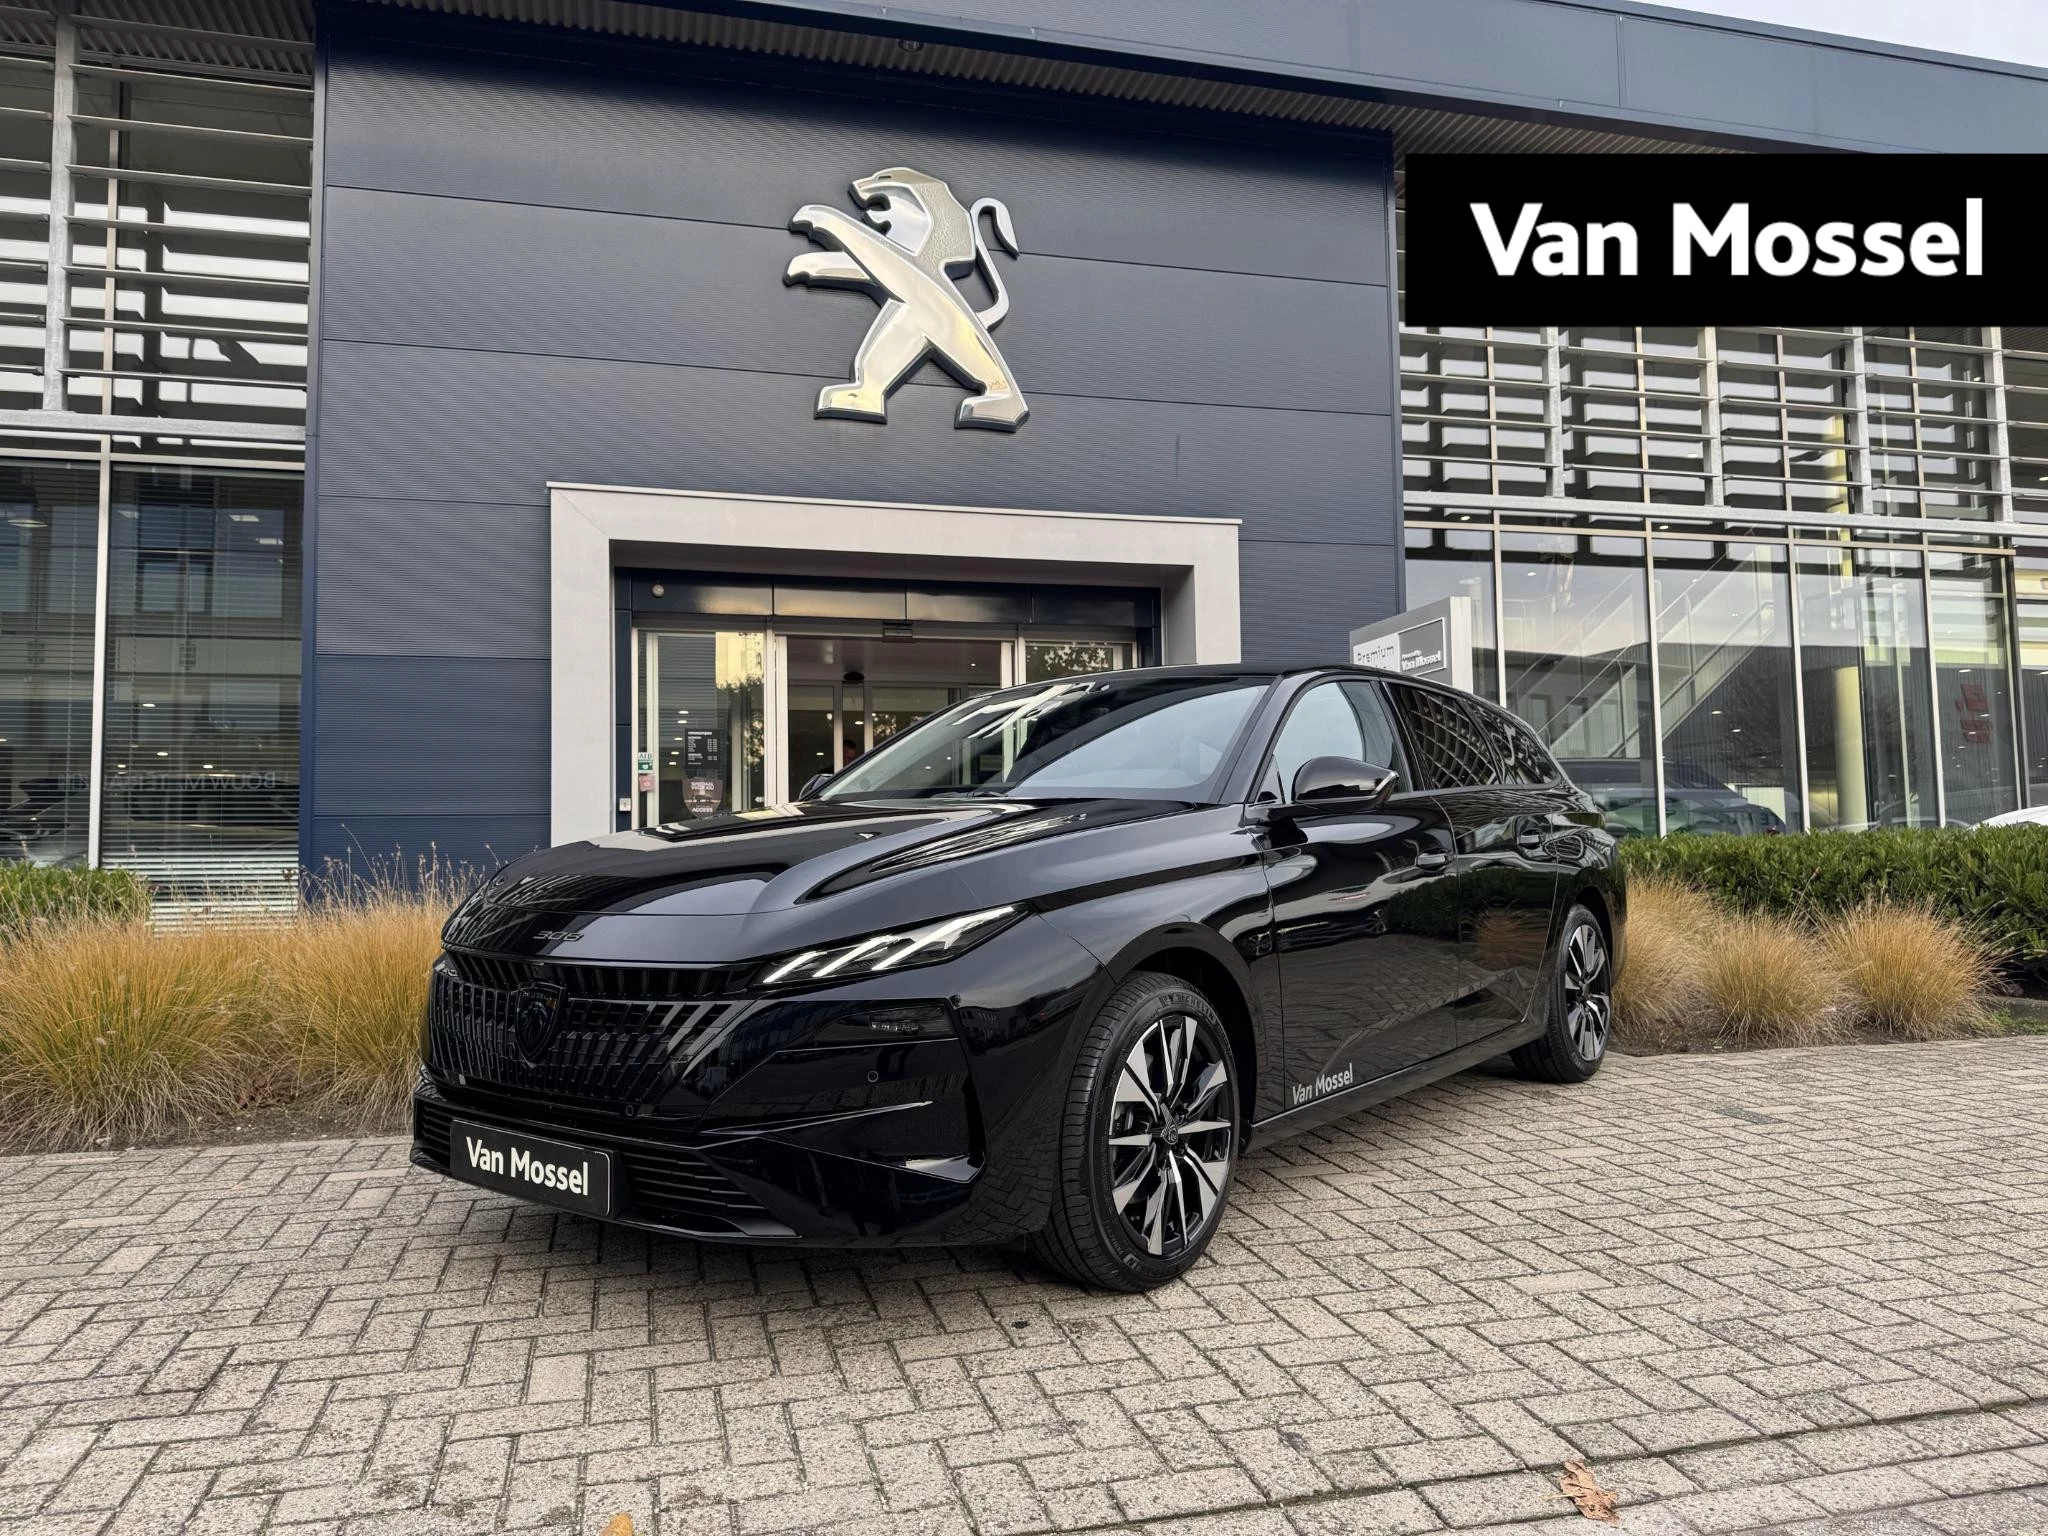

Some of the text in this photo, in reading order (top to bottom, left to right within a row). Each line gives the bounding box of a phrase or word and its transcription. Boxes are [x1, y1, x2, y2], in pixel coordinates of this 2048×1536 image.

[1357, 645, 1395, 663] Premium
[1401, 660, 1415, 671] Van
[1415, 650, 1441, 667] Mossel
[1292, 1062, 1354, 1105] Van Mossel
[466, 1136, 589, 1196] Van Mossel
